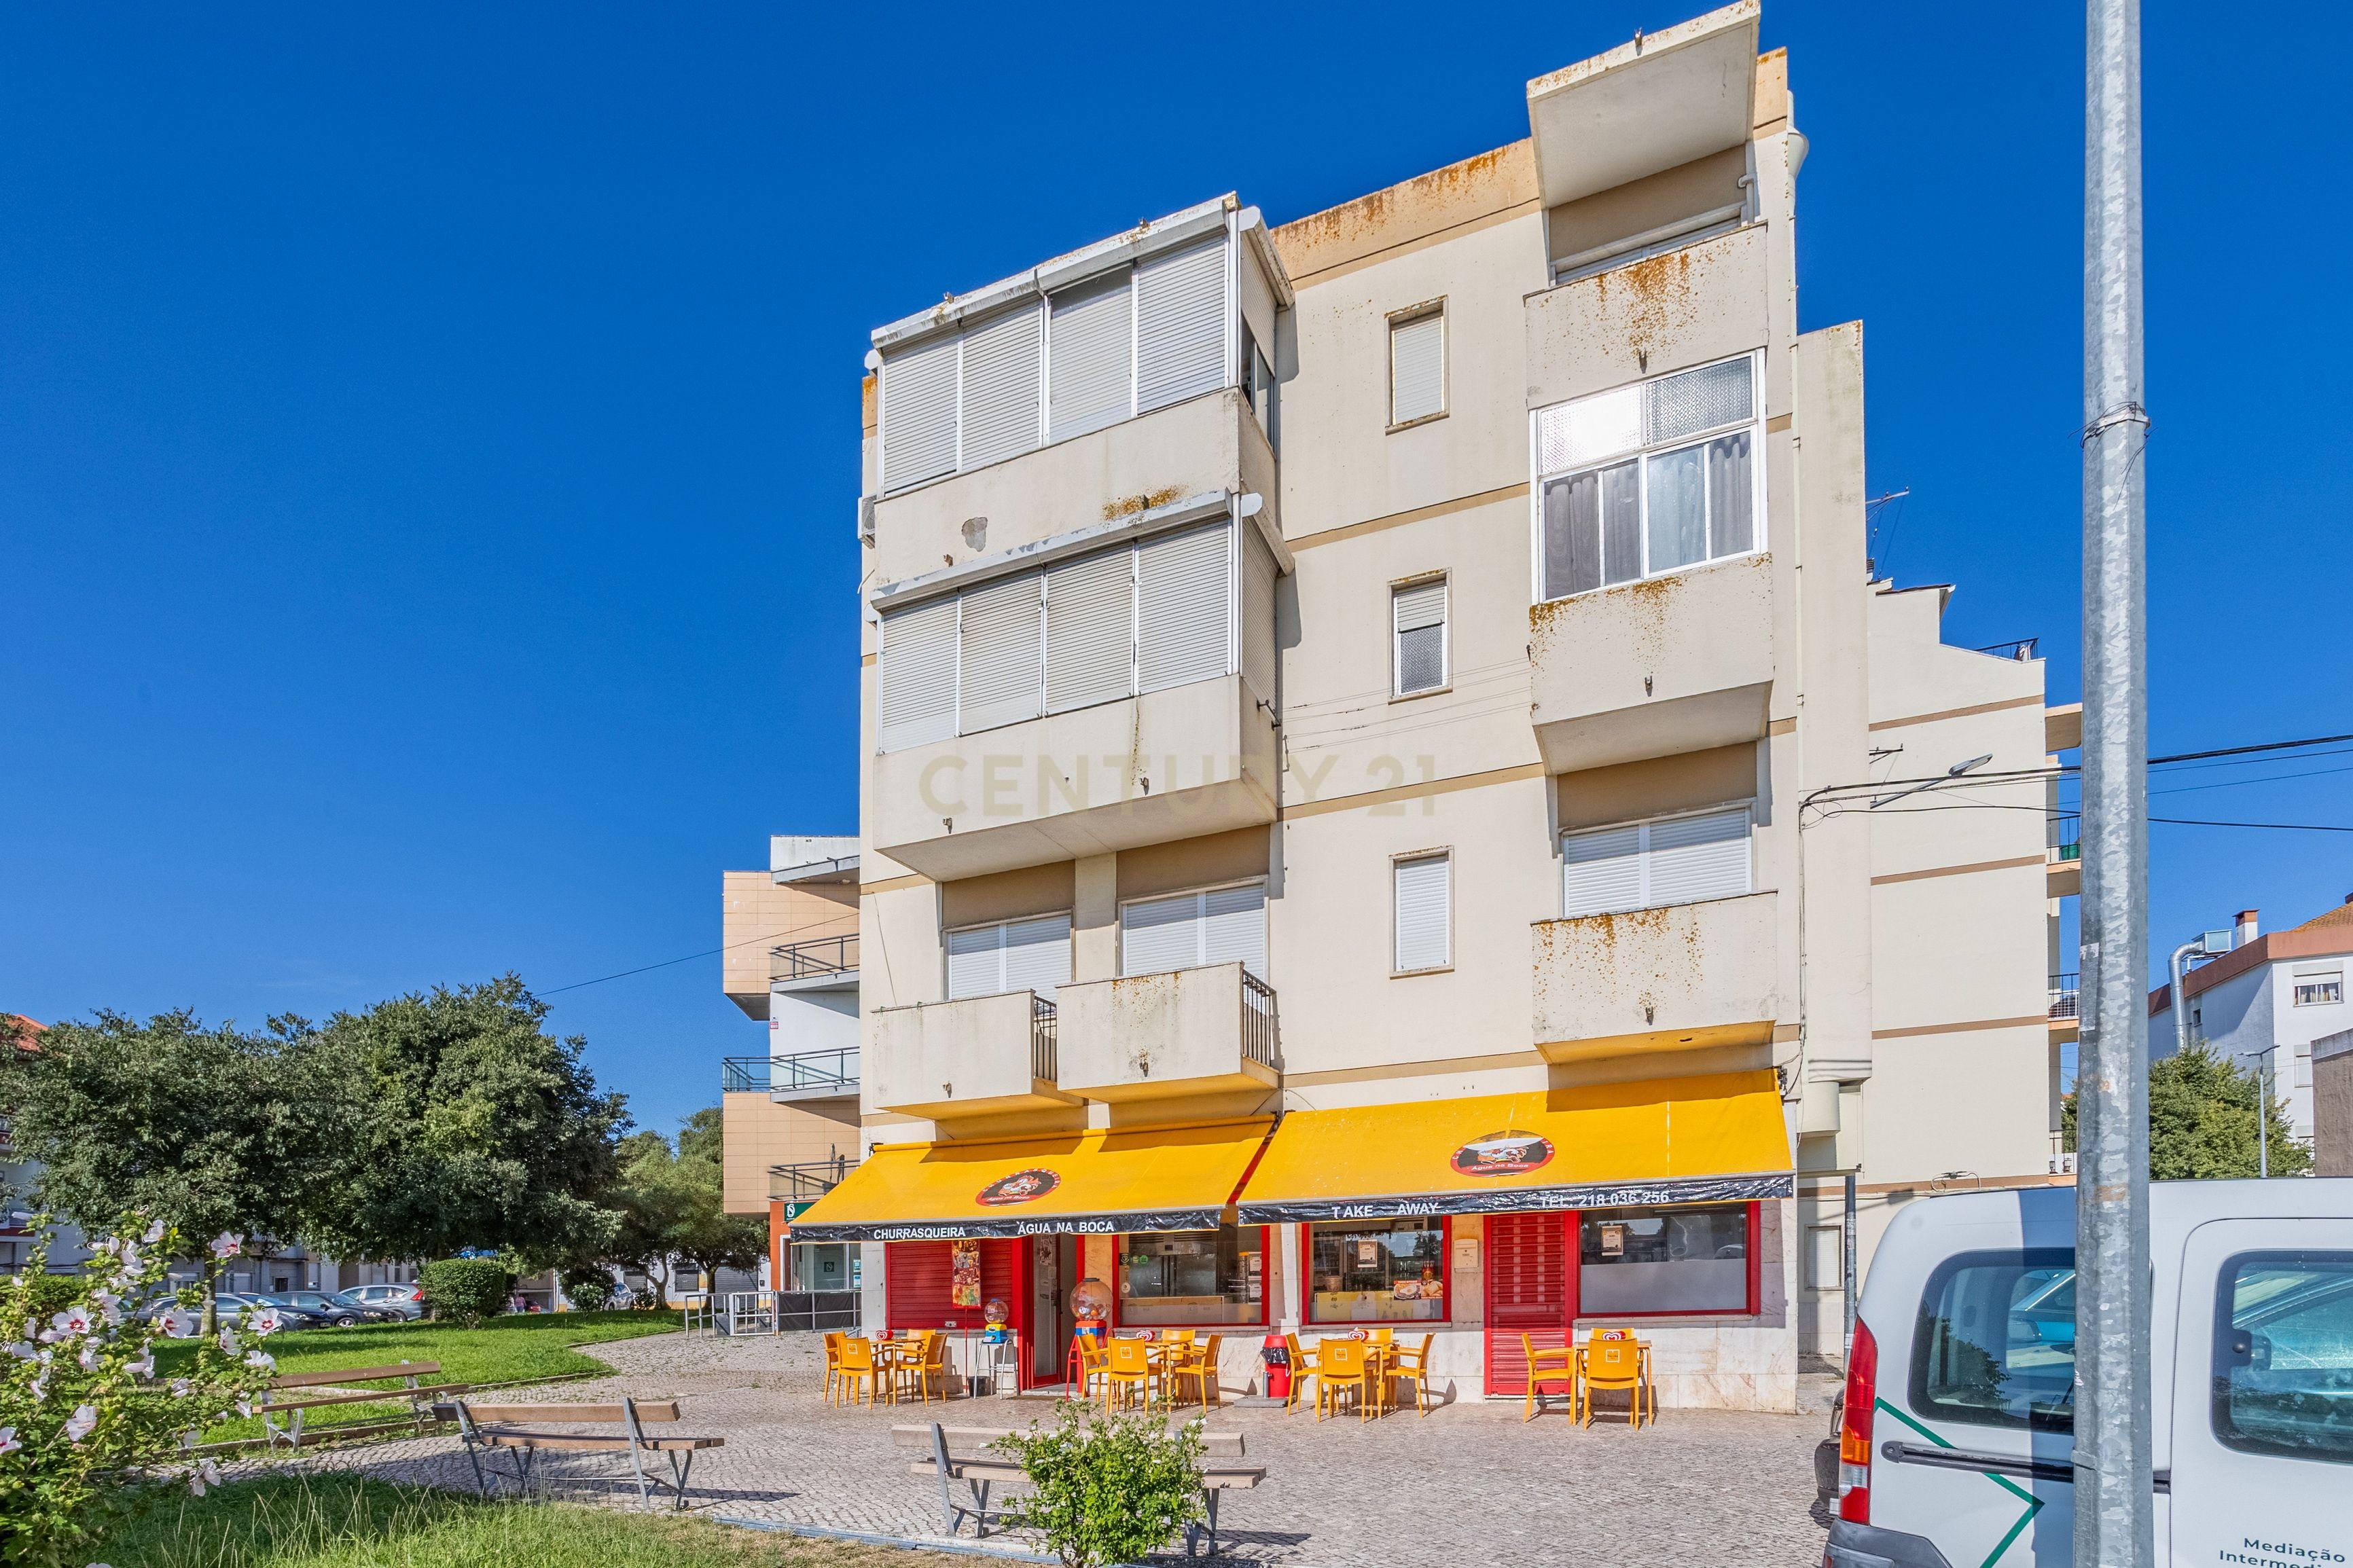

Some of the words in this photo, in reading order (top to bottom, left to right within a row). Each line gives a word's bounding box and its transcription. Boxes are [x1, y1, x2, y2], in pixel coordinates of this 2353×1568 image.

[1579, 1194, 1605, 1206] 218
[1610, 1193, 1638, 1206] 036
[1642, 1190, 1670, 1203] 256
[1397, 1202, 1439, 1215] AWAY
[874, 1226, 966, 1240] CHURRASQUEIRA
[1018, 1221, 1052, 1235] ÁGUA
[1056, 1222, 1073, 1233] NA
[1079, 1220, 1115, 1233] BOCA
[2220, 1550, 2321, 1568] Interme
[2244, 1537, 2346, 1563] Mediação
